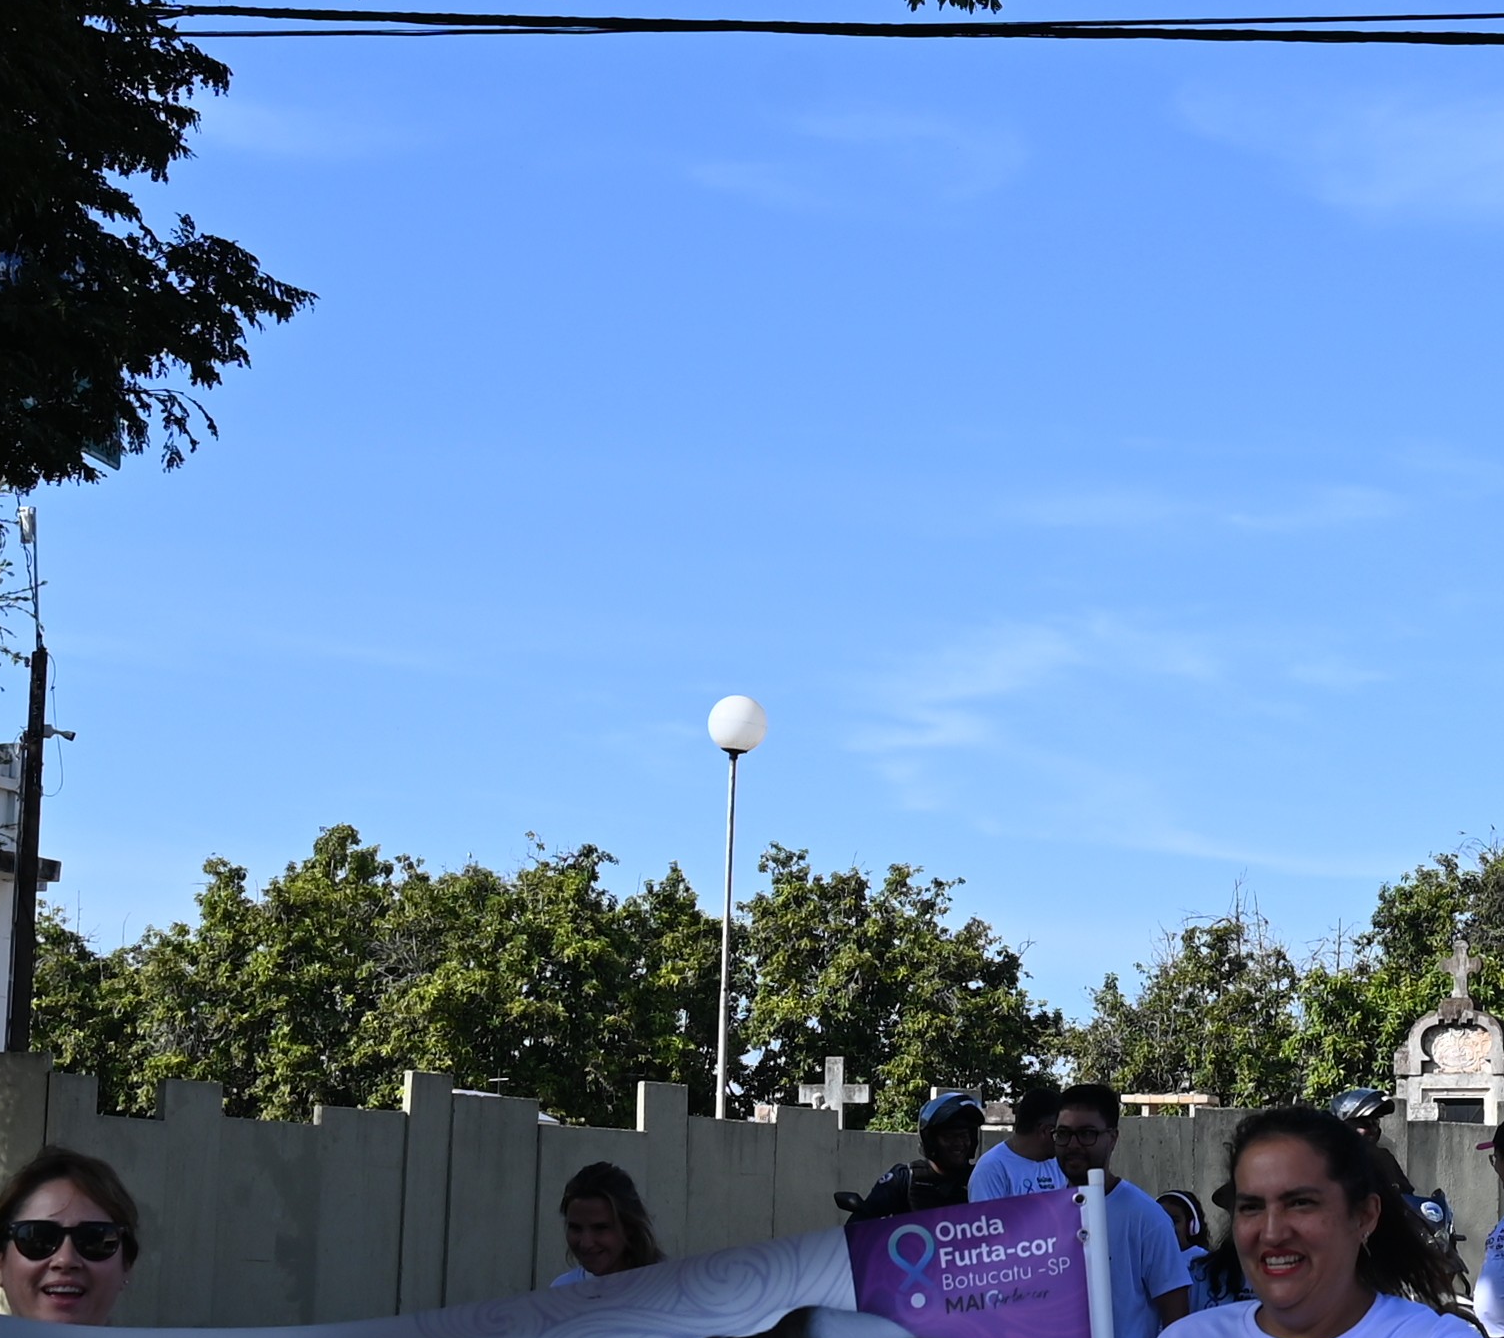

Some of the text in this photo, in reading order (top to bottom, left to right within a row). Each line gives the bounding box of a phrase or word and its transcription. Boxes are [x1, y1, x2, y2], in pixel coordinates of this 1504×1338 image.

[935, 1215, 1004, 1242] Onda
[939, 1237, 1057, 1268] Furta-cor
[942, 1265, 1032, 1291] Botucatu
